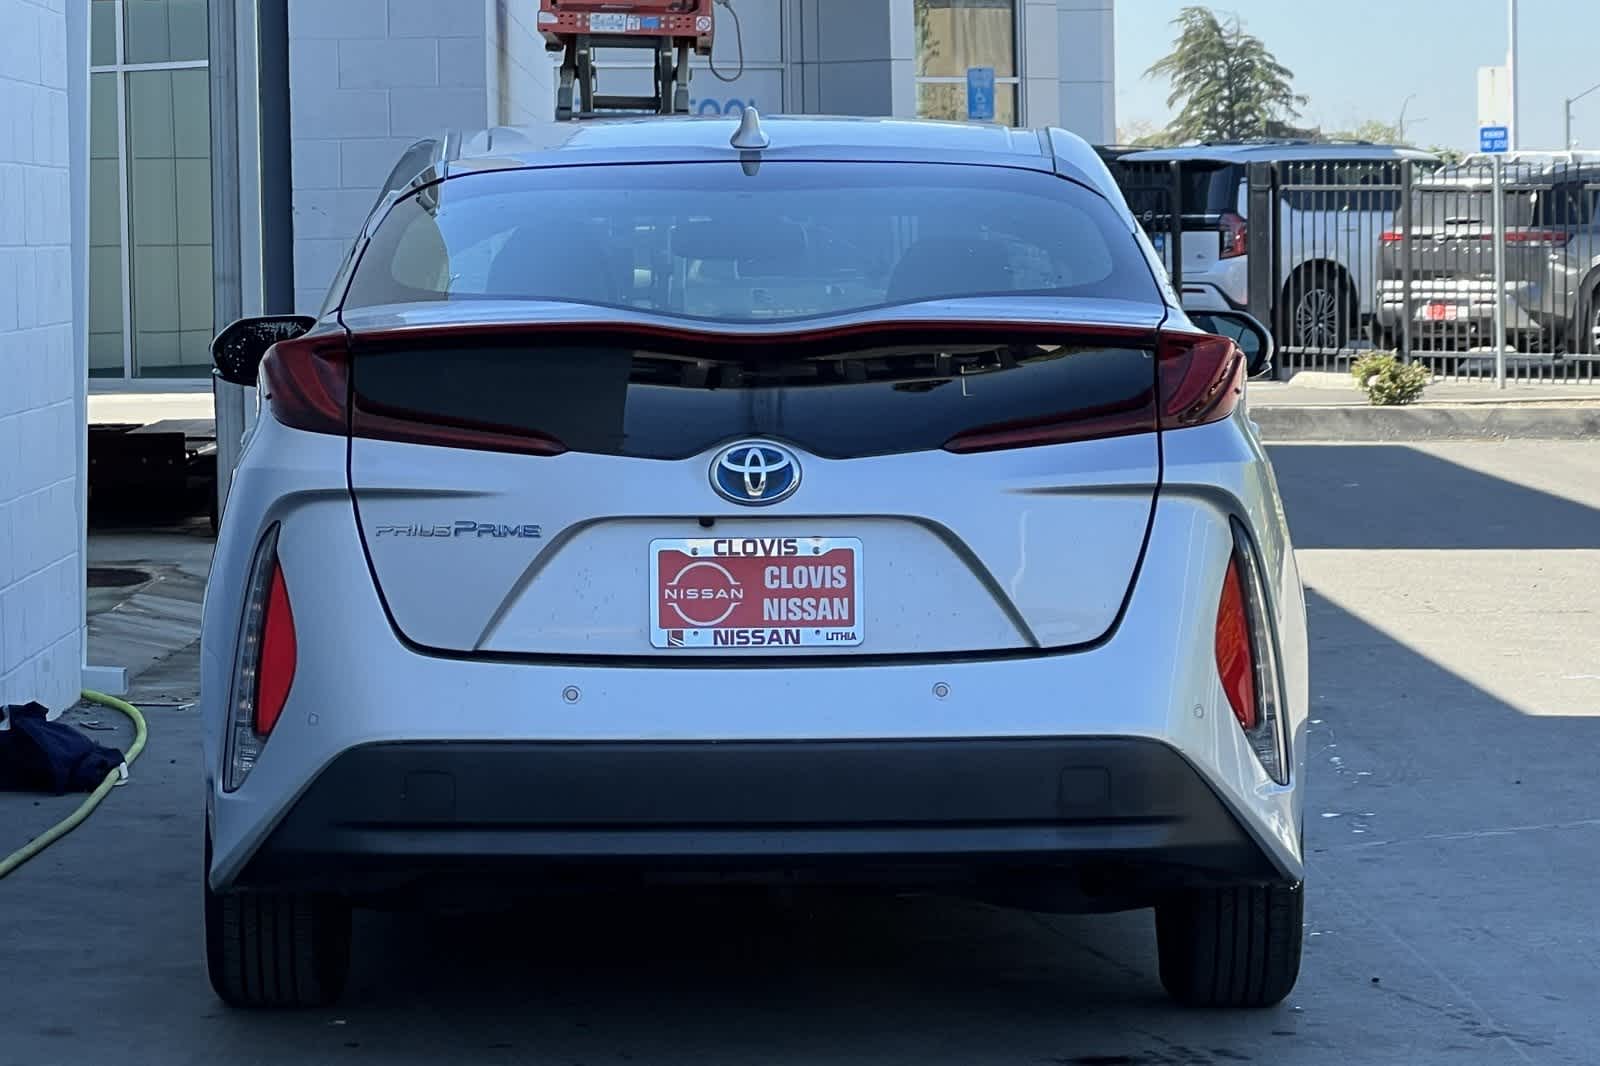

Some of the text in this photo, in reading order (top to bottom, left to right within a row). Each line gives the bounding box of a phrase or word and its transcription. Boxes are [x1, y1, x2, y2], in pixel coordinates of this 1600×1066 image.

[454, 520, 542, 538] PRIME
[713, 539, 799, 556] CLOVIS
[764, 565, 847, 589] CLOVIS
[664, 588, 744, 599] NISSAN
[763, 597, 849, 621] NISSAN
[713, 629, 801, 646] NISSAN
[825, 632, 857, 641] LITHIA
